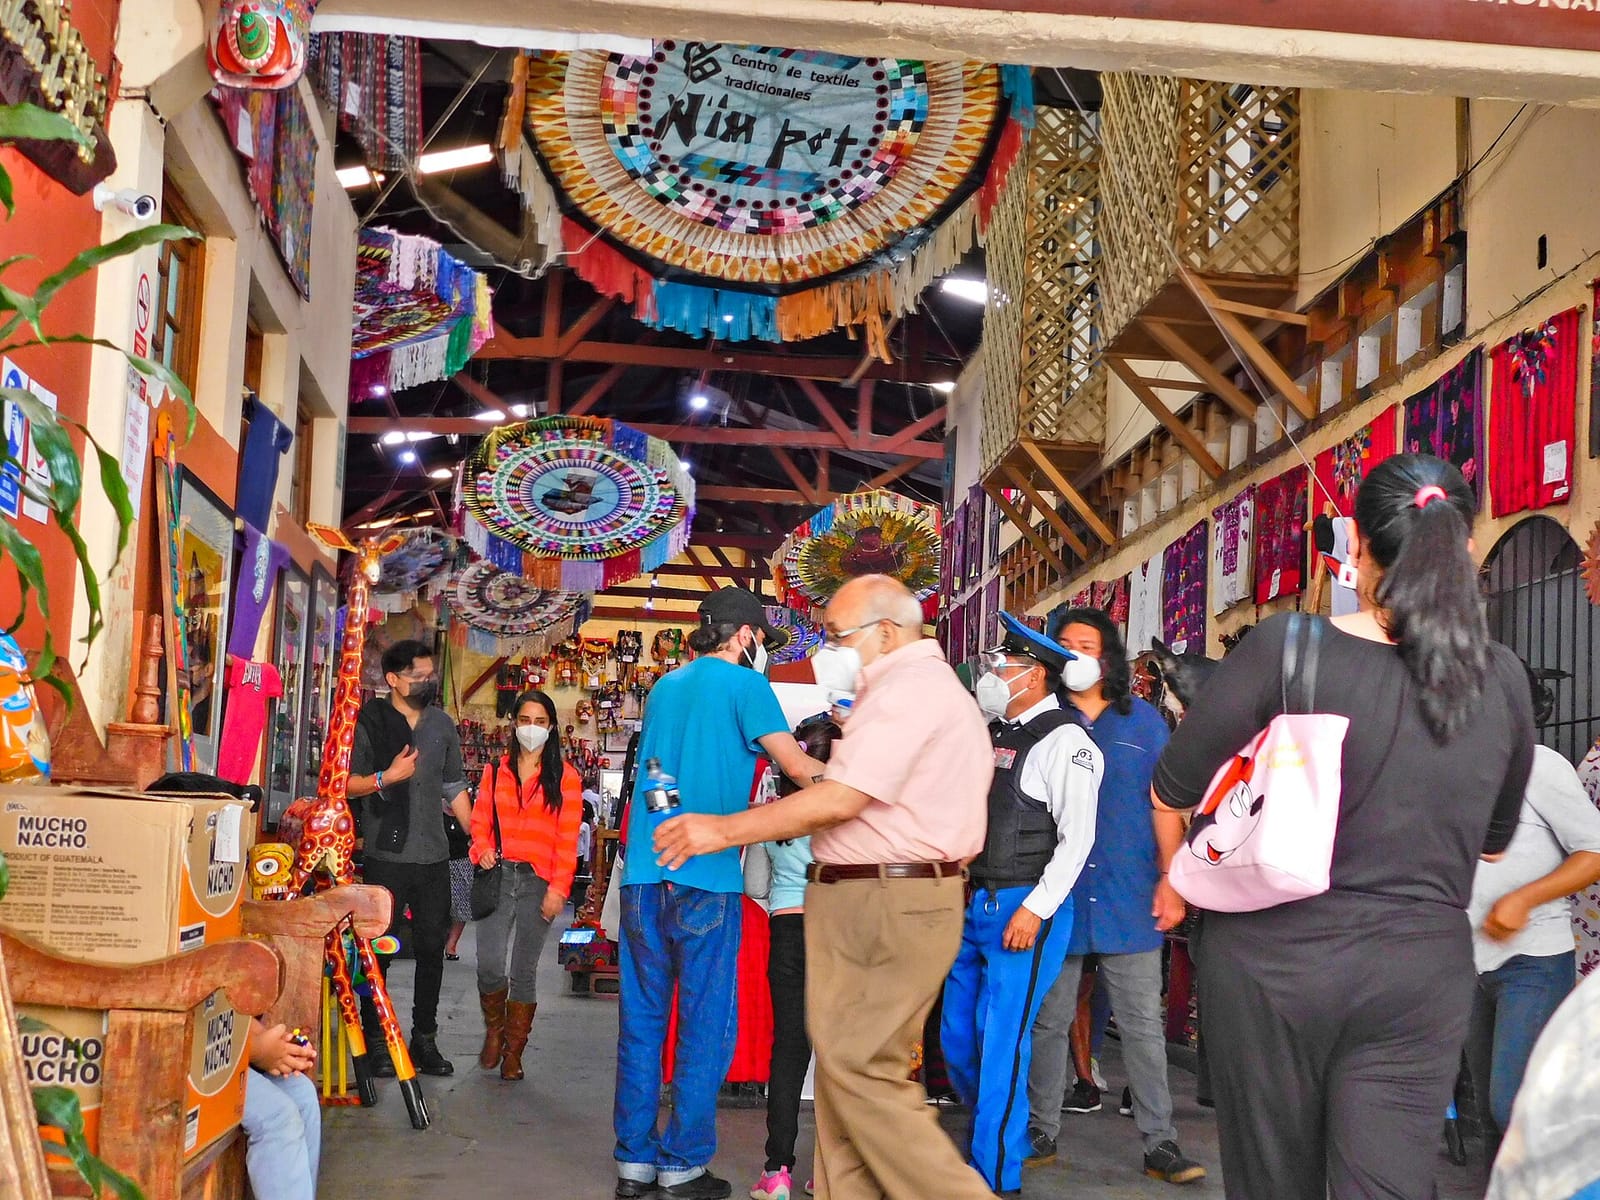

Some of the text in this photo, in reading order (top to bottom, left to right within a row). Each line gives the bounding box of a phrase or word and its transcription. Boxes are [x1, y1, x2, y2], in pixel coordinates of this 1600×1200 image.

[732, 54, 860, 88] Centro de textiles
[725, 75, 812, 101] tradicionales
[19, 816, 87, 833] MUCHO
[18, 832, 87, 848] NACHO
[3, 852, 104, 864] RODUCT OF GUATEMALA
[207, 865, 233, 896] NACHO
[207, 1009, 234, 1045] MUCHO
[22, 1036, 102, 1060] UCHO
[204, 1039, 232, 1076] NACHO
[24, 1060, 100, 1084] ACHO
